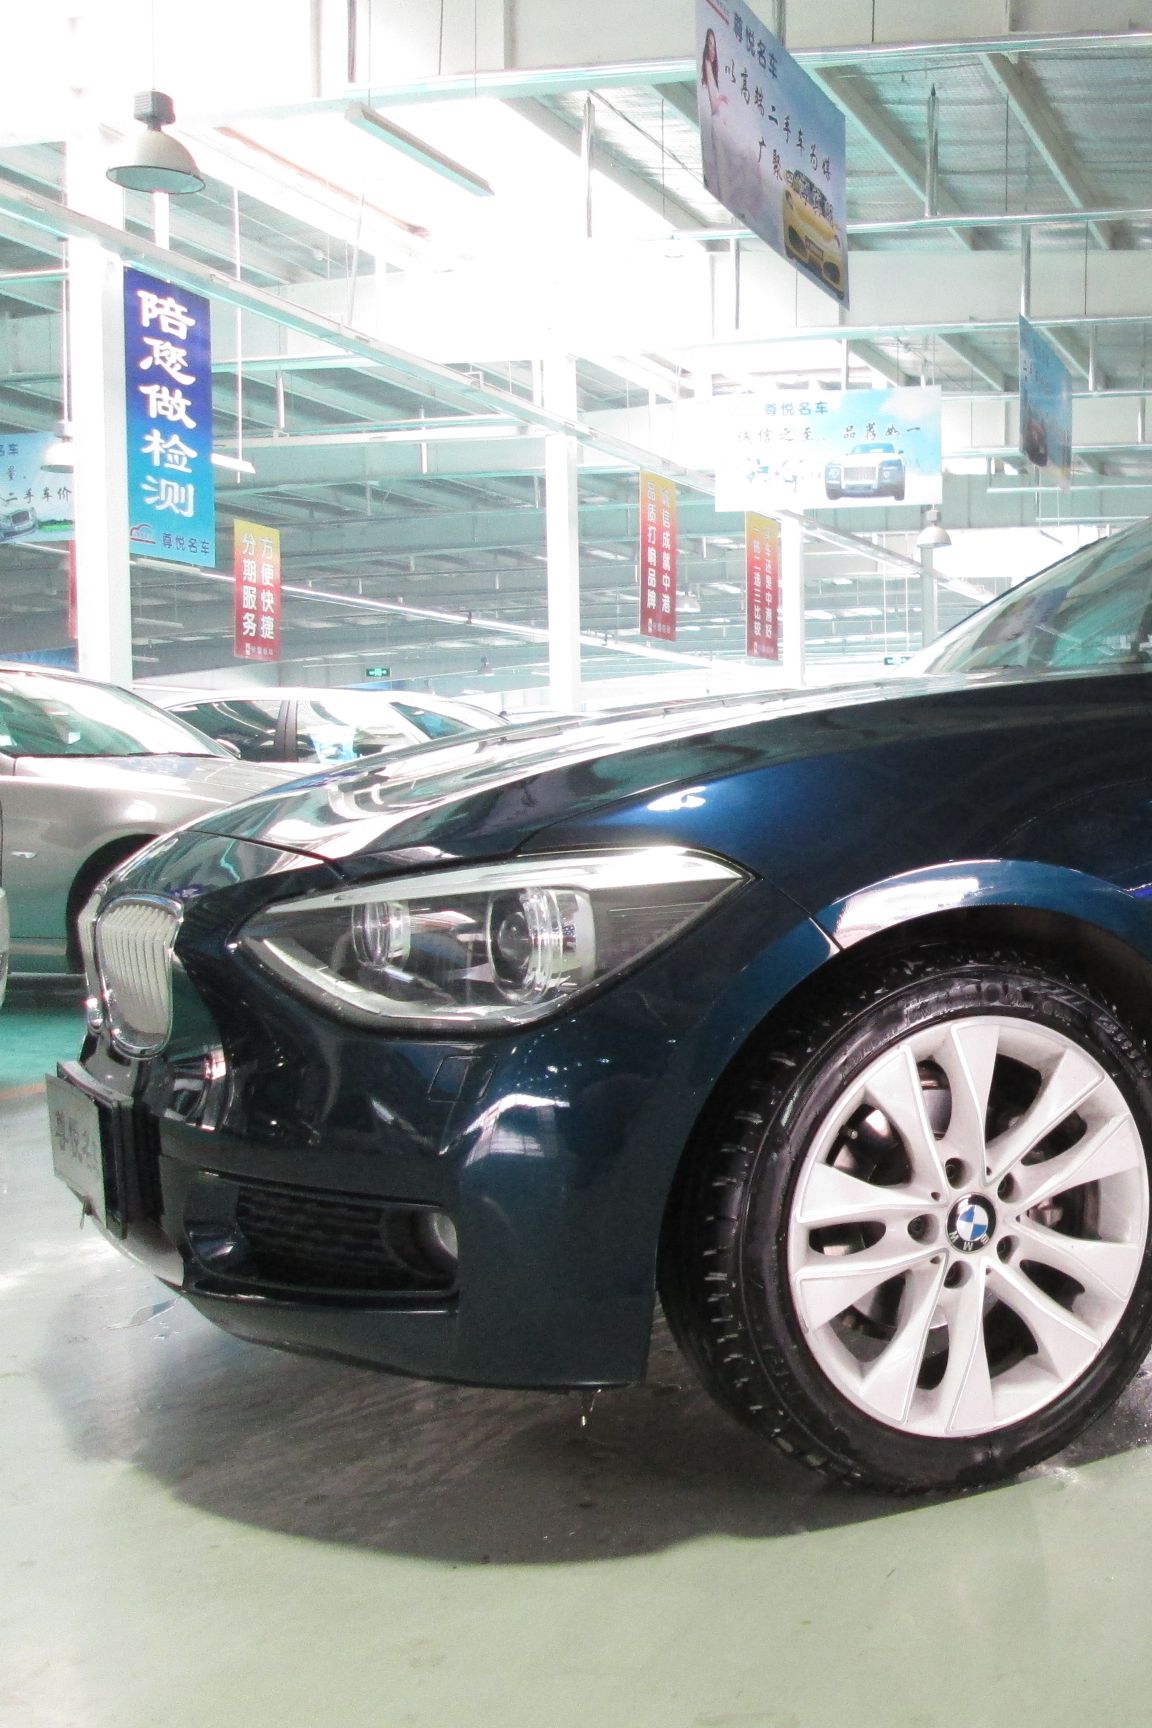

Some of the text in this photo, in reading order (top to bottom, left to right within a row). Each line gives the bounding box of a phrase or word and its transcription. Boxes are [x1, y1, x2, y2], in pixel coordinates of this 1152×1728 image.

[137, 289, 199, 518] 陪您做检测
[765, 401, 829, 417] 尊悦名车
[0, 486, 73, 503] 二手车价
[161, 531, 210, 555] 尊悦名车
[242, 533, 257, 637] 分期服务
[260, 538, 275, 640] 方便快捷
